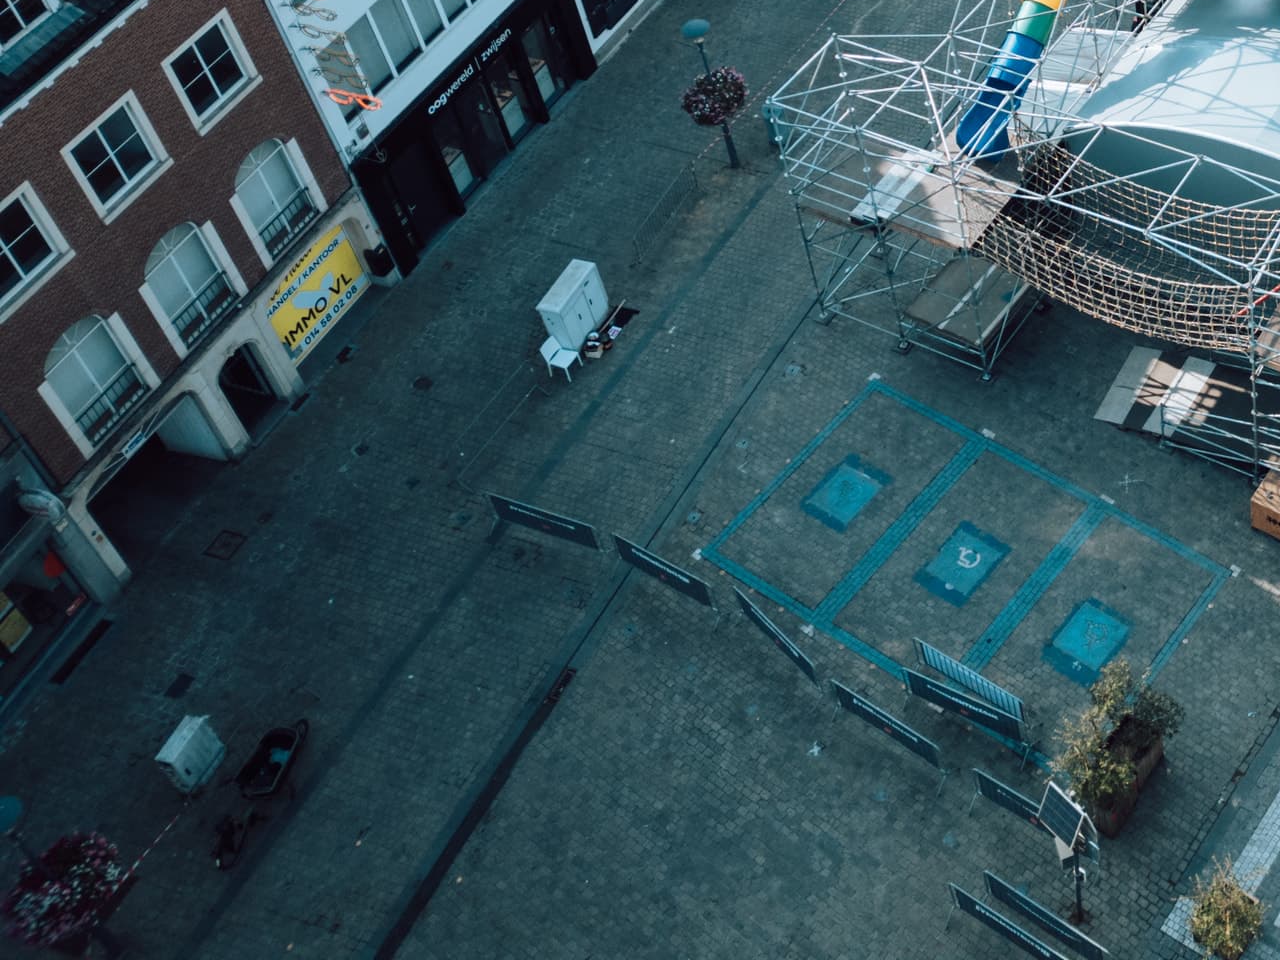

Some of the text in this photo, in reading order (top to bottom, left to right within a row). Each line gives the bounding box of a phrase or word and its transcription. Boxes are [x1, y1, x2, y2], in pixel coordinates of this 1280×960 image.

[428, 28, 511, 114] oogwereld zwijsen
[266, 285, 298, 318] HANDEL
[302, 239, 339, 280] KANTOOR
[283, 273, 352, 347] IMMO VL
[304, 285, 358, 345] 014 58 02 08
